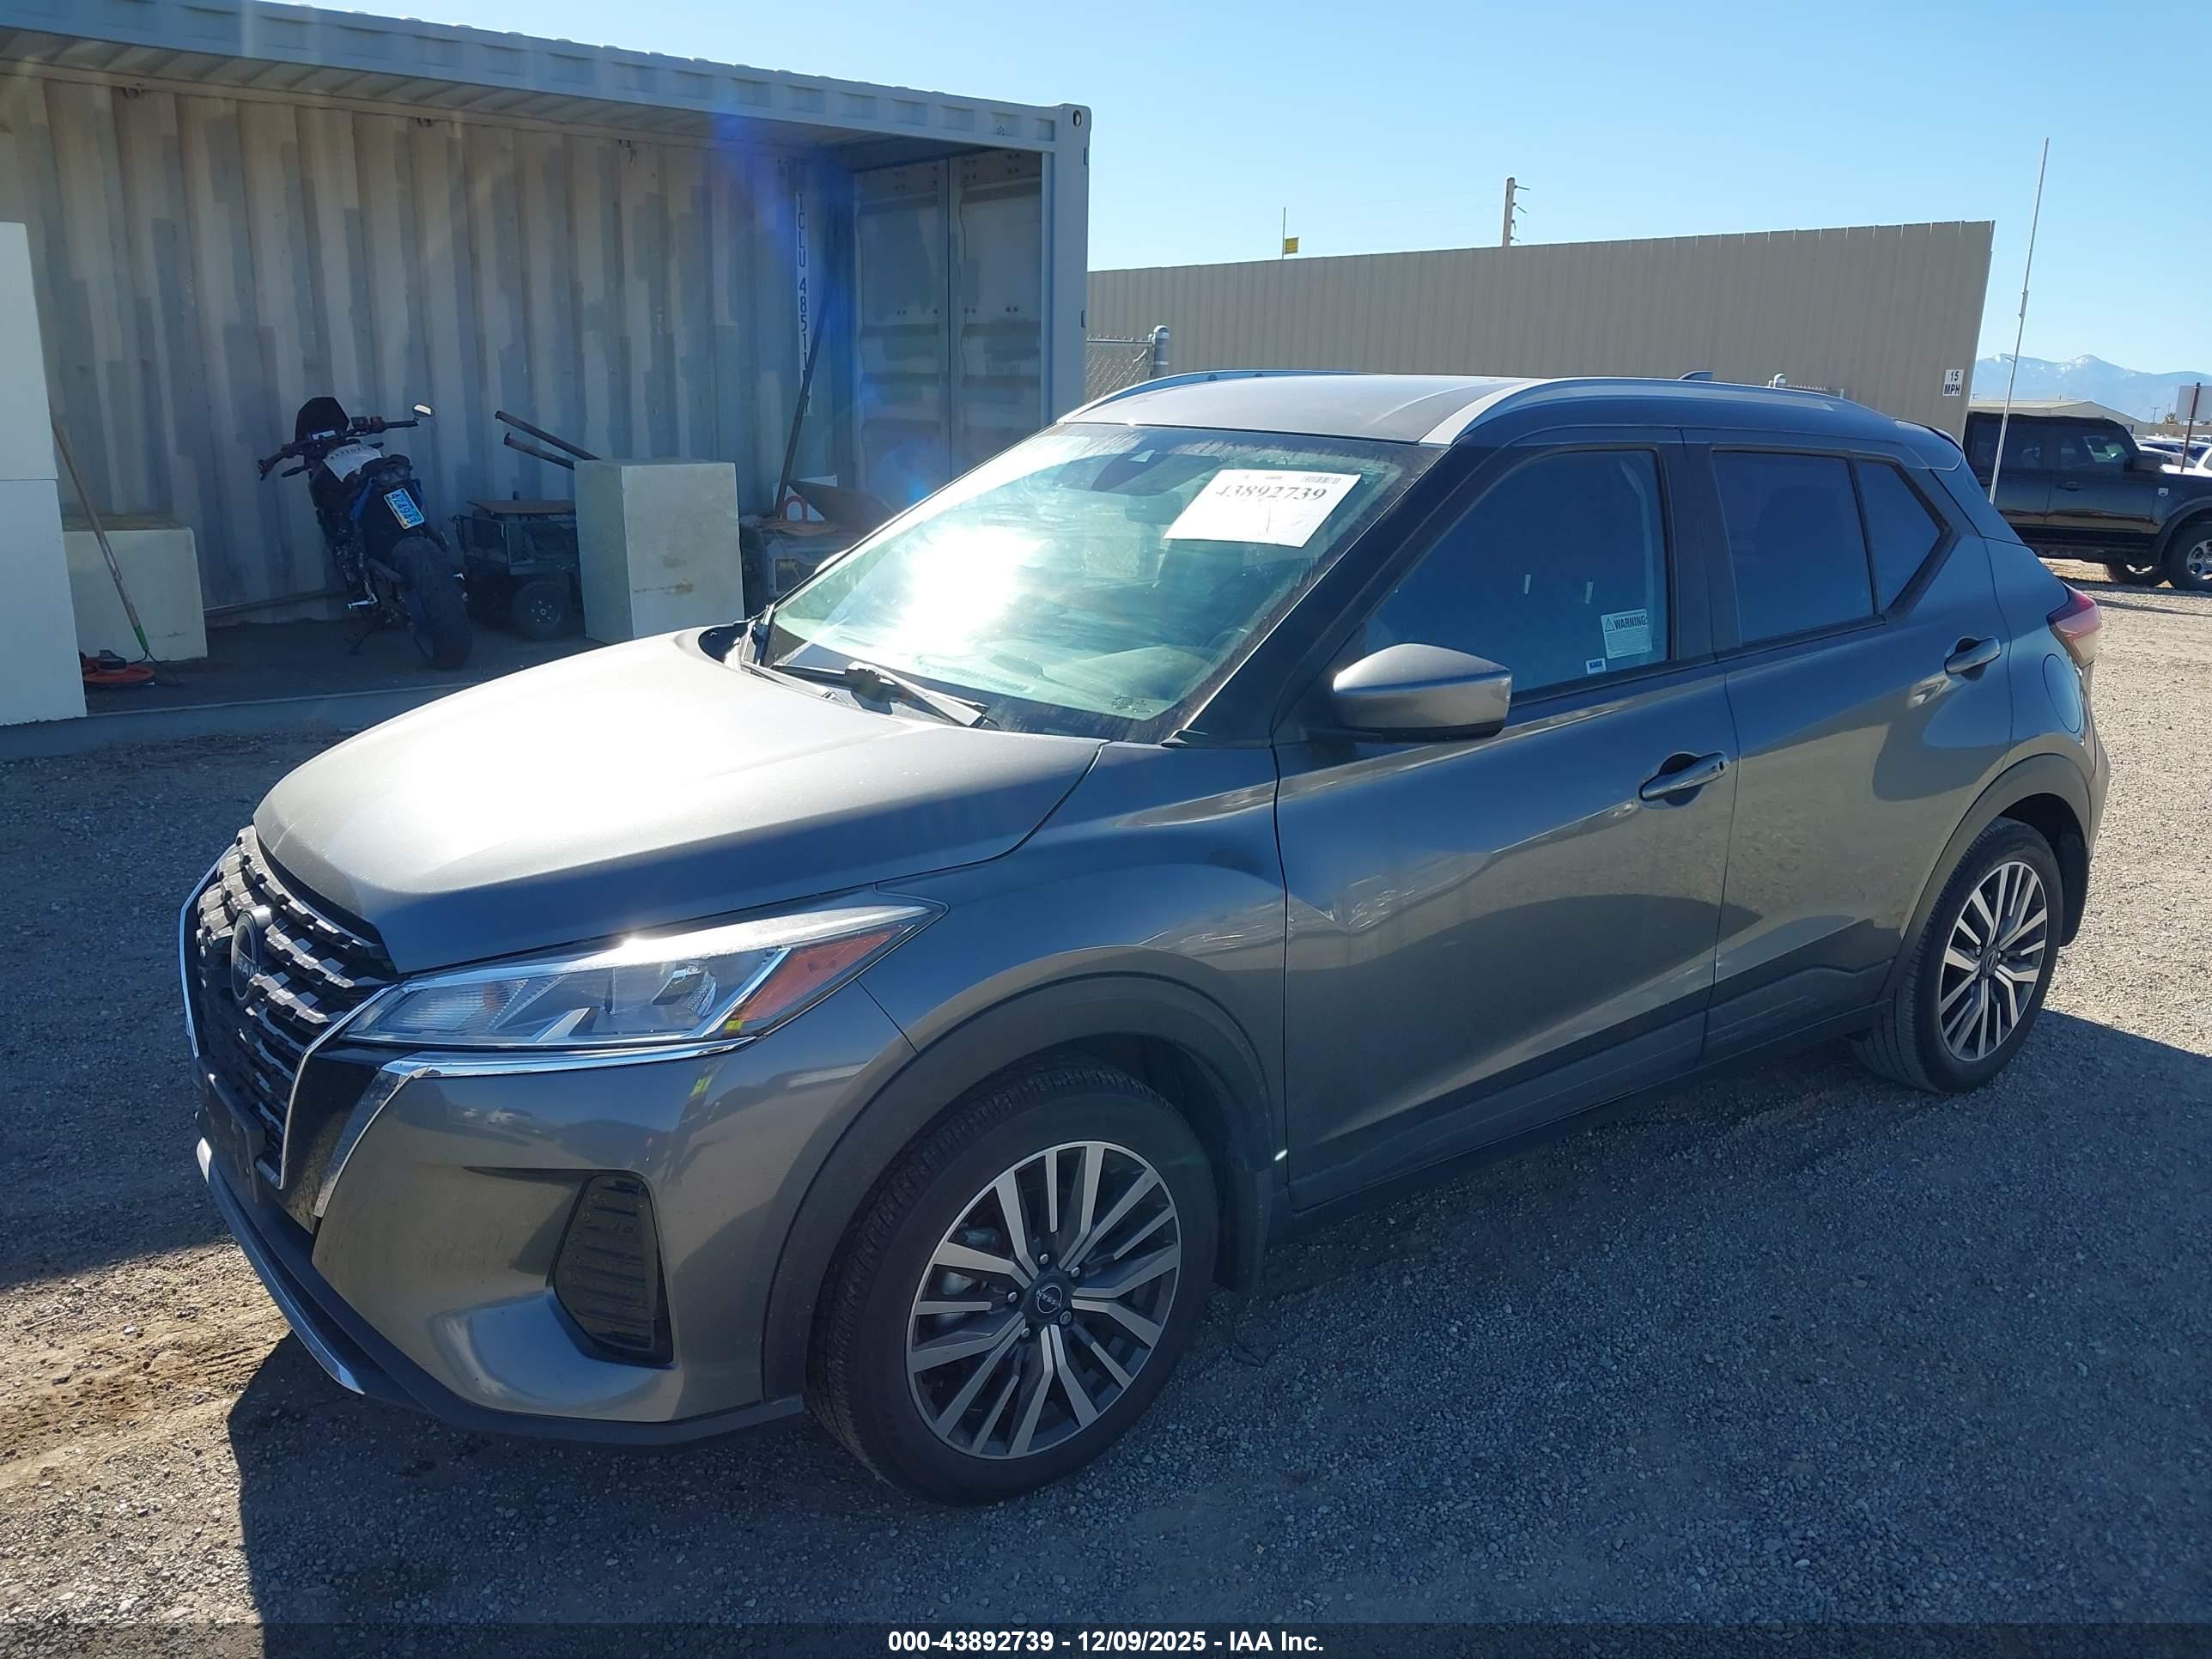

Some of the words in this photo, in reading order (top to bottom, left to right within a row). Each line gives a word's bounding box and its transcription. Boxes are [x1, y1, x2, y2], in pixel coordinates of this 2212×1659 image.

[798, 192, 806, 268] ICLU
[799, 277, 810, 380] 48511
[1944, 384, 1960, 395] MPH
[1950, 371, 1960, 381] 15
